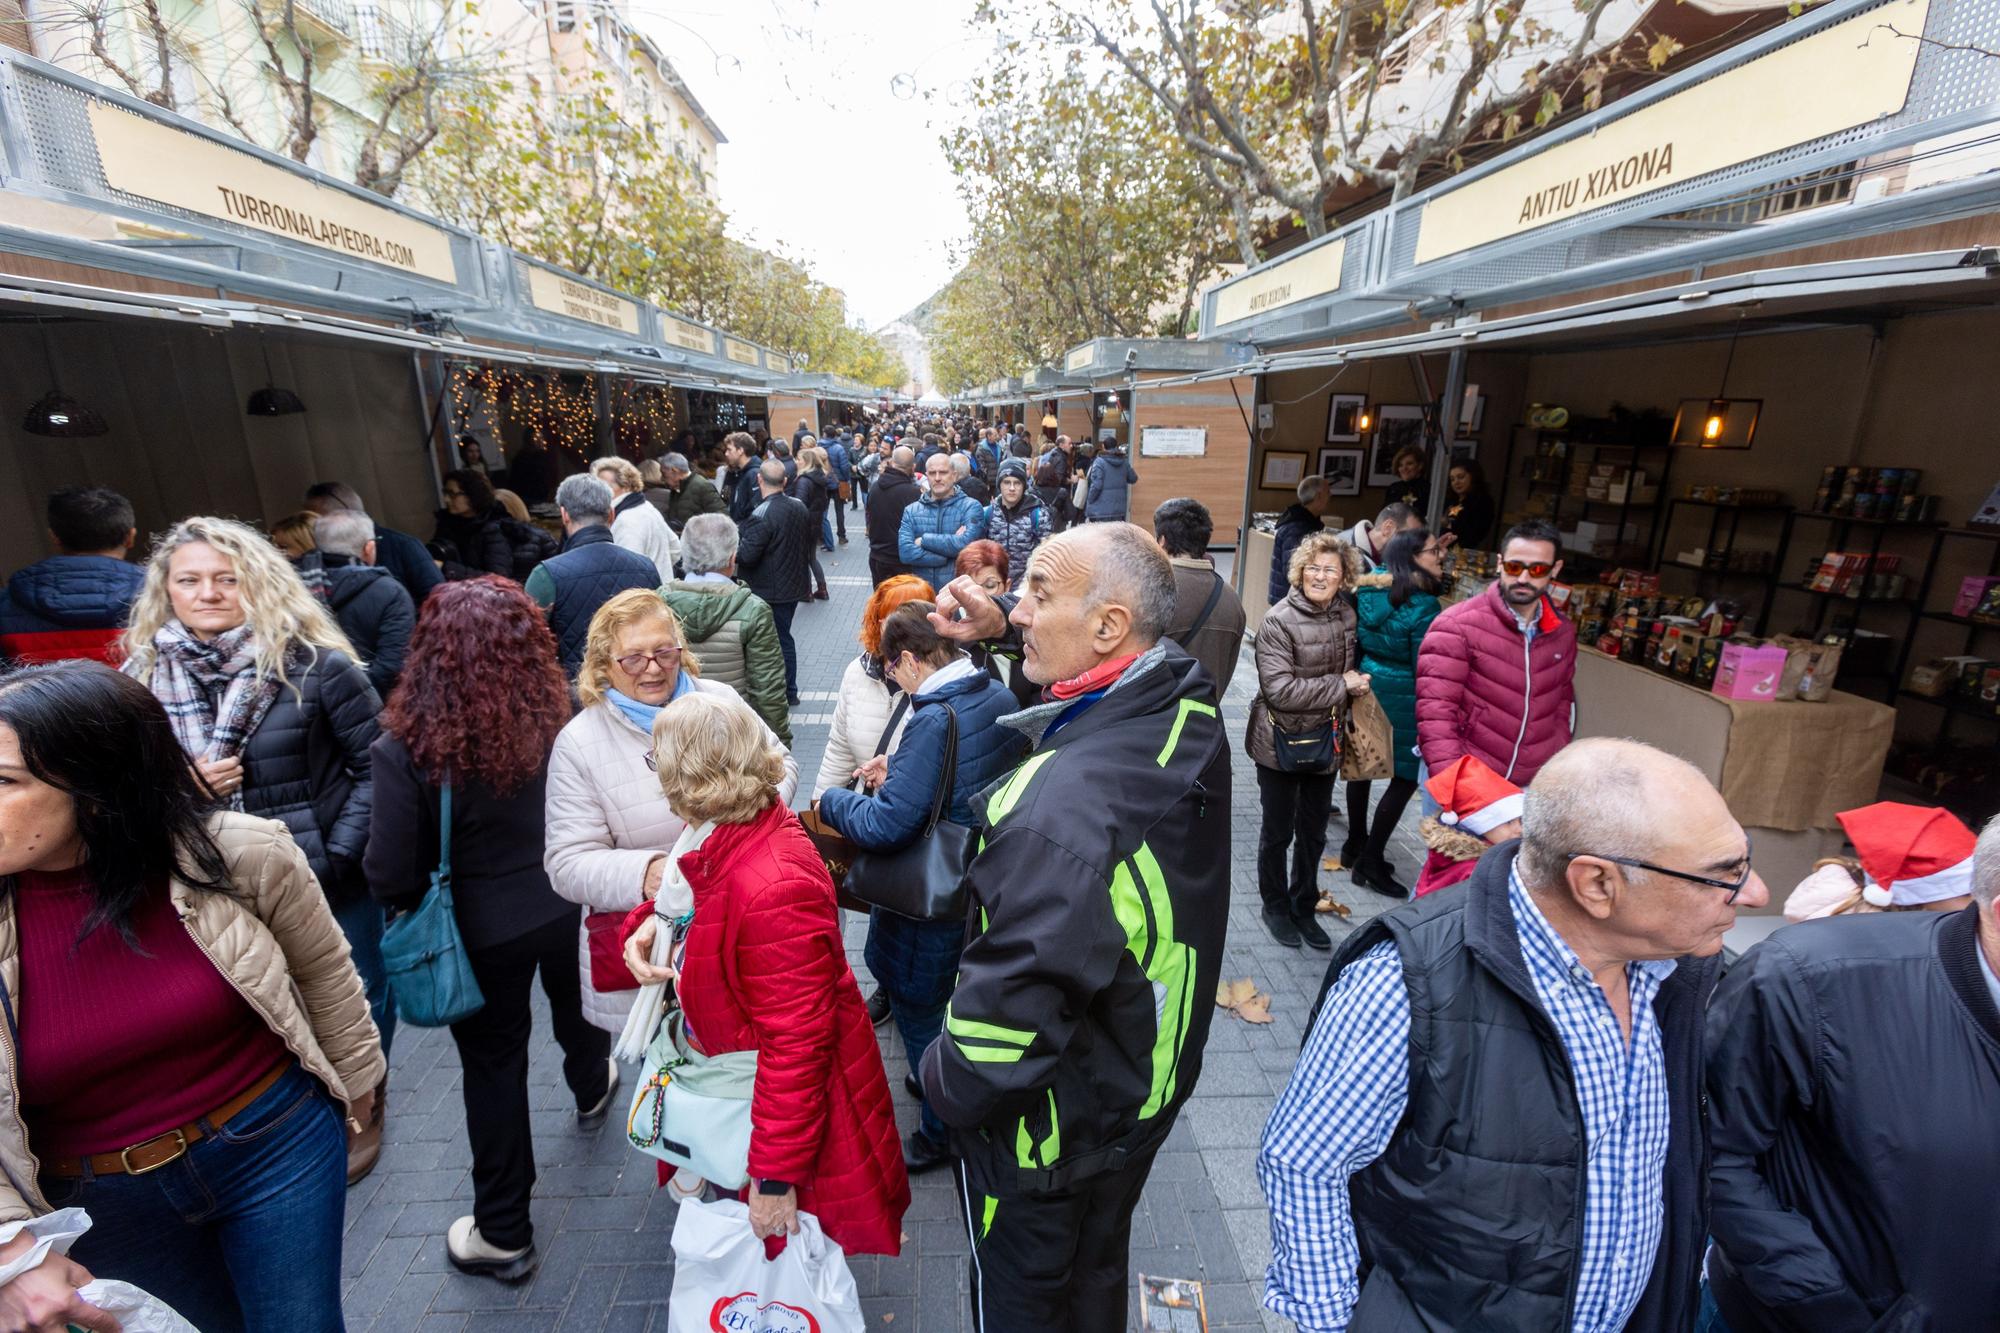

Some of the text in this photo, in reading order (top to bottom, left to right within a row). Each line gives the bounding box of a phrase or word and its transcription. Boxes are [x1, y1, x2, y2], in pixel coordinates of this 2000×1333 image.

[1518, 142, 1674, 225] ANTIU XIXONA
[217, 185, 417, 269] TURRONALAPIEDRA.COM
